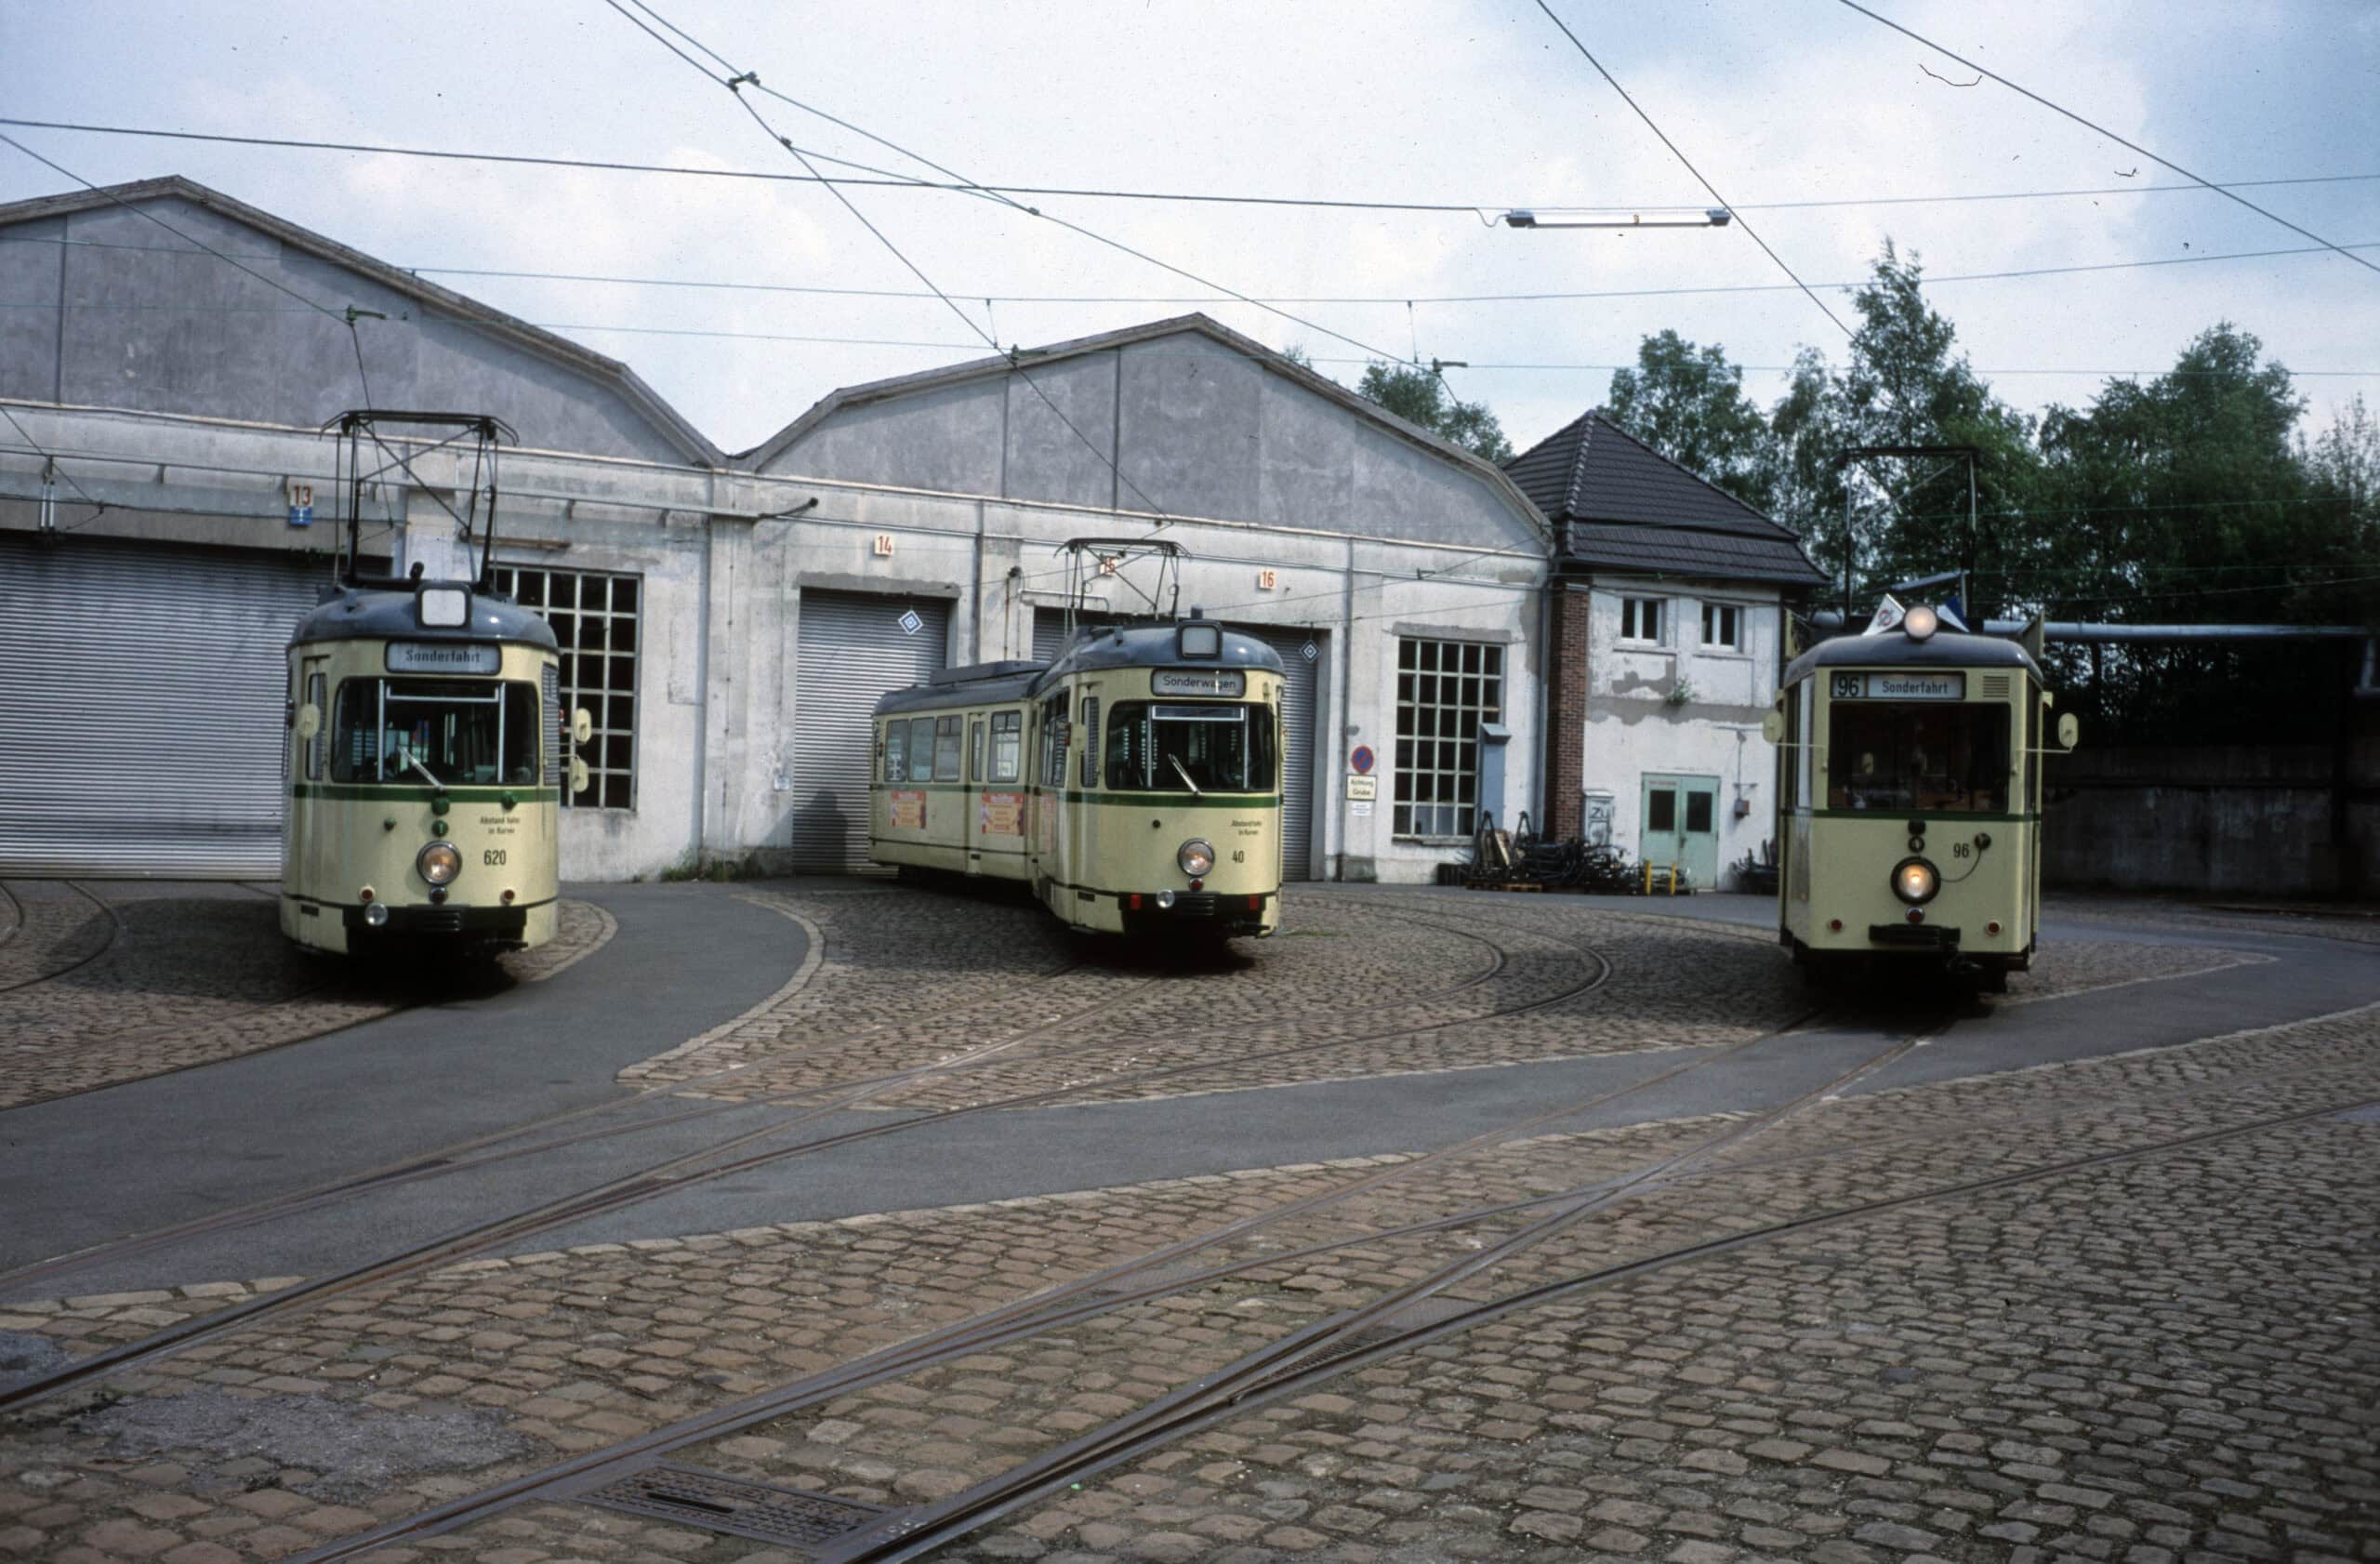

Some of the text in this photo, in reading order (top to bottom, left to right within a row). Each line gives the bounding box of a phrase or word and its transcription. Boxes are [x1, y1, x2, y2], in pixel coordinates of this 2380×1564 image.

[294, 485, 311, 507] 13
[879, 535, 892, 553] 14
[1262, 570, 1275, 588] 16
[405, 649, 481, 663] Sonderfahrt
[1162, 675, 1236, 690] Sonderwagen
[1837, 675, 1950, 697] 96 Sonderfahrt
[483, 850, 507, 866] 620
[1232, 850, 1244, 864] 40
[1953, 842, 1970, 858] 96
